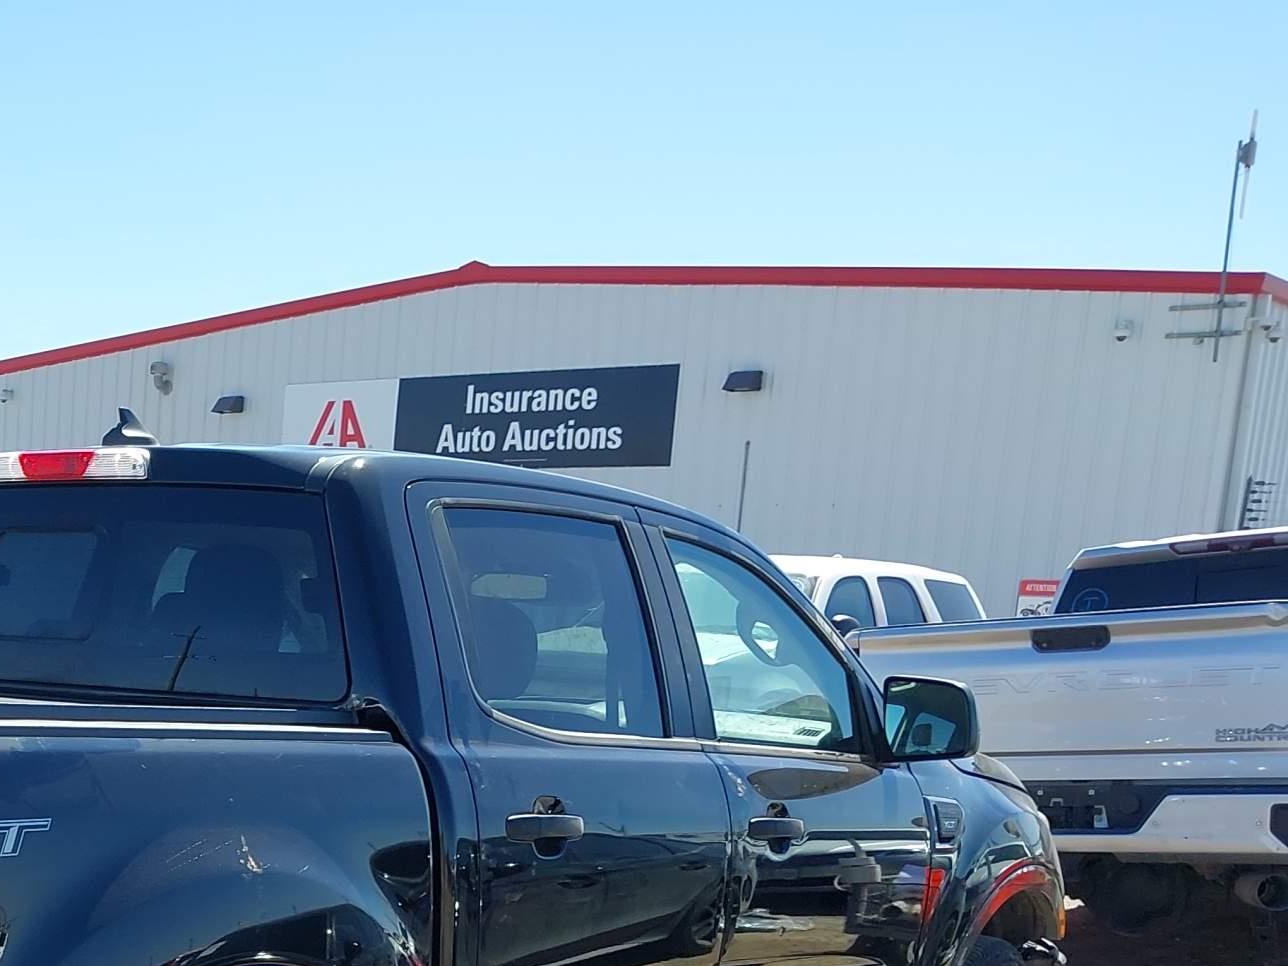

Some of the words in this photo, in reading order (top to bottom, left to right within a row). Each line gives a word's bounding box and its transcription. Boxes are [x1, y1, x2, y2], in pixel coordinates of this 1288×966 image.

[466, 385, 598, 415] Insurance
[436, 424, 495, 454] Auto
[502, 420, 623, 452] Auctions
[1215, 735, 1288, 743] COUNTR
